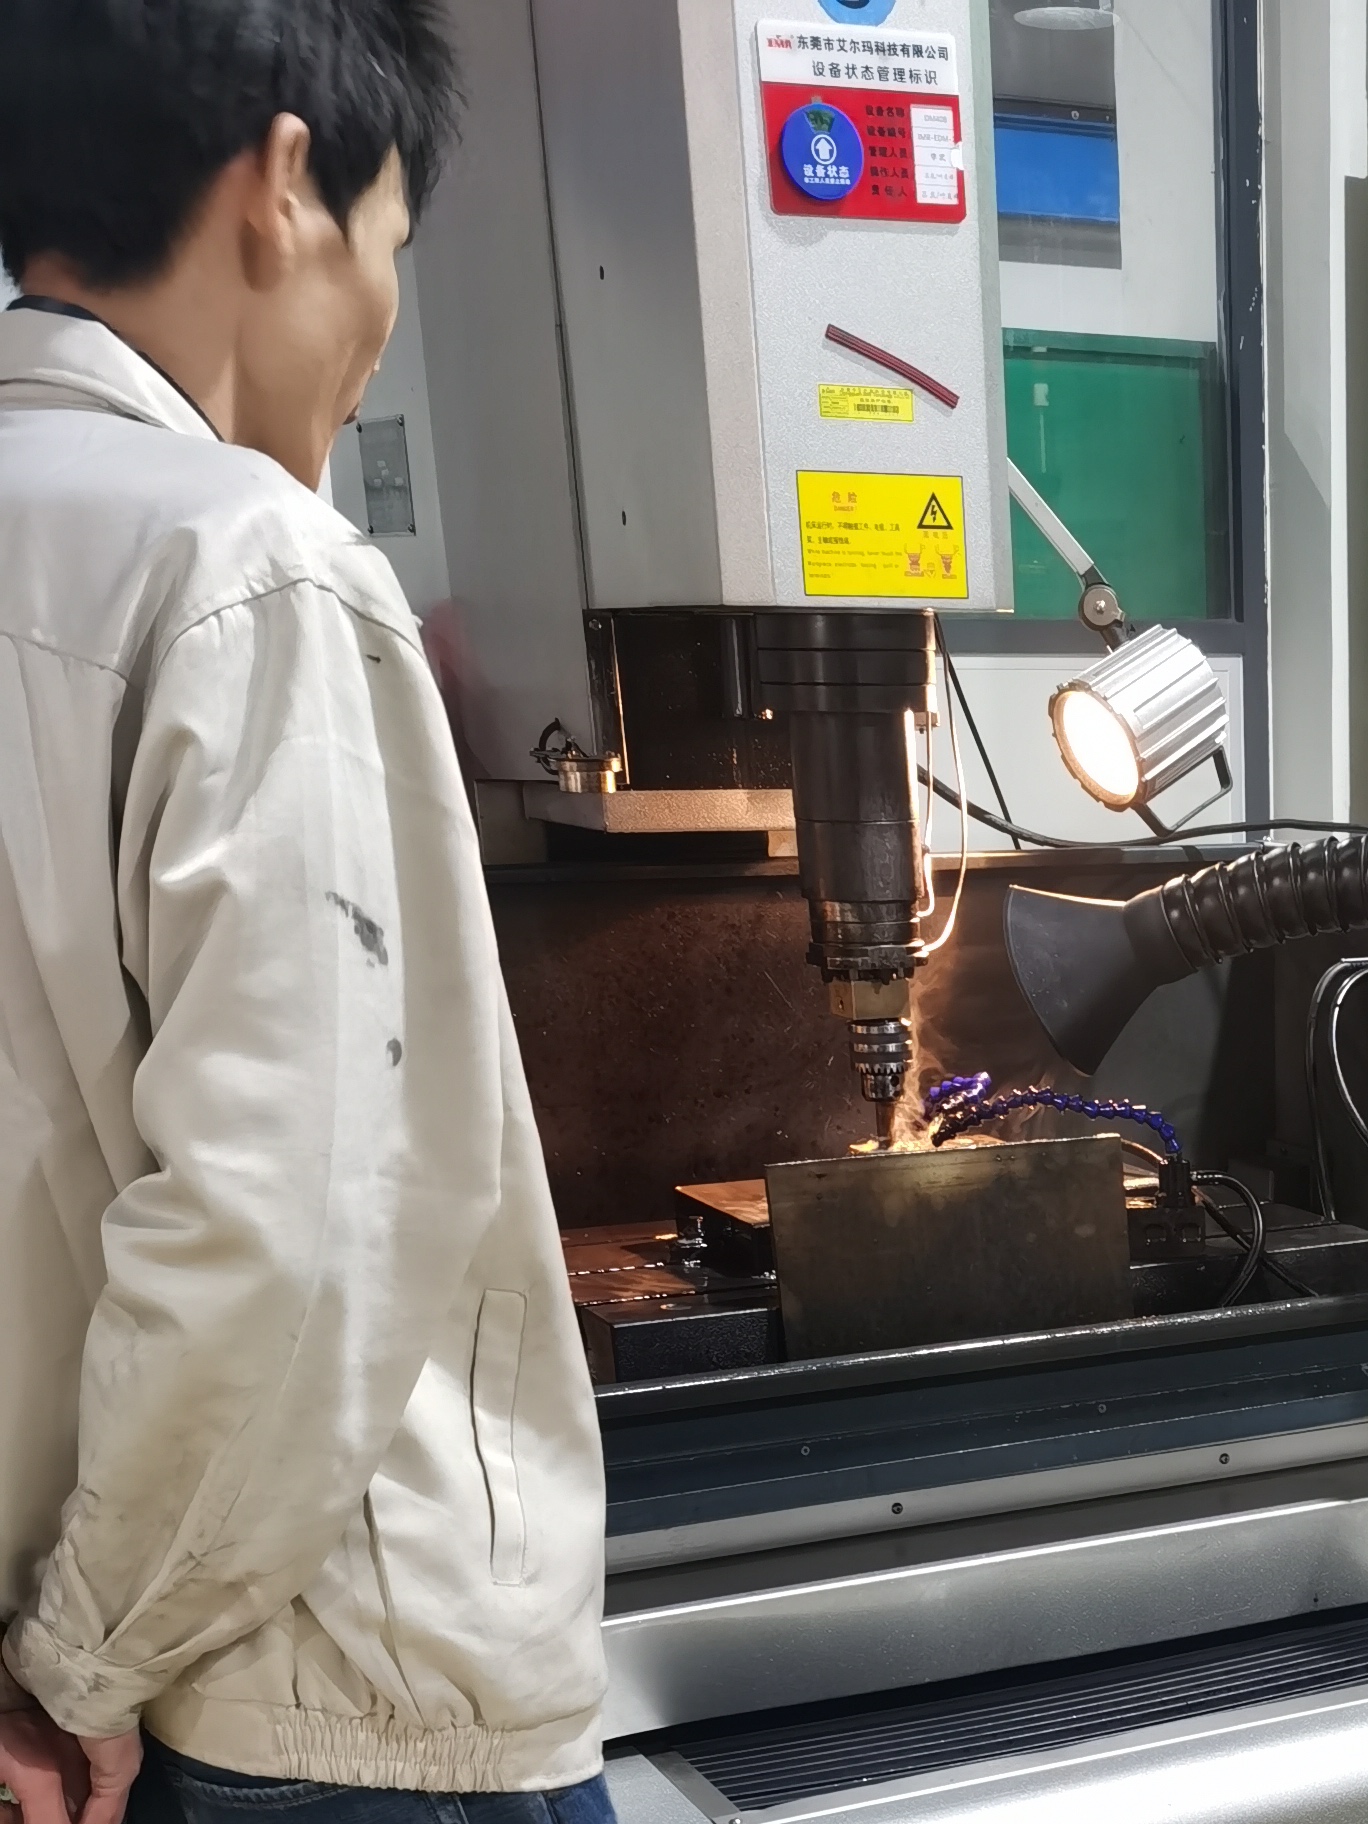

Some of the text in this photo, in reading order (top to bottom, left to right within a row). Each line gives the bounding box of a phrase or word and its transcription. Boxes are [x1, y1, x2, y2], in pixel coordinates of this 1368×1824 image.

[797, 34, 949, 61] 东莞市艾尔玛科技有限公司
[812, 60, 938, 85] 设备状态管理标识
[803, 164, 850, 178] 设备状态
[832, 491, 857, 503] 危险
